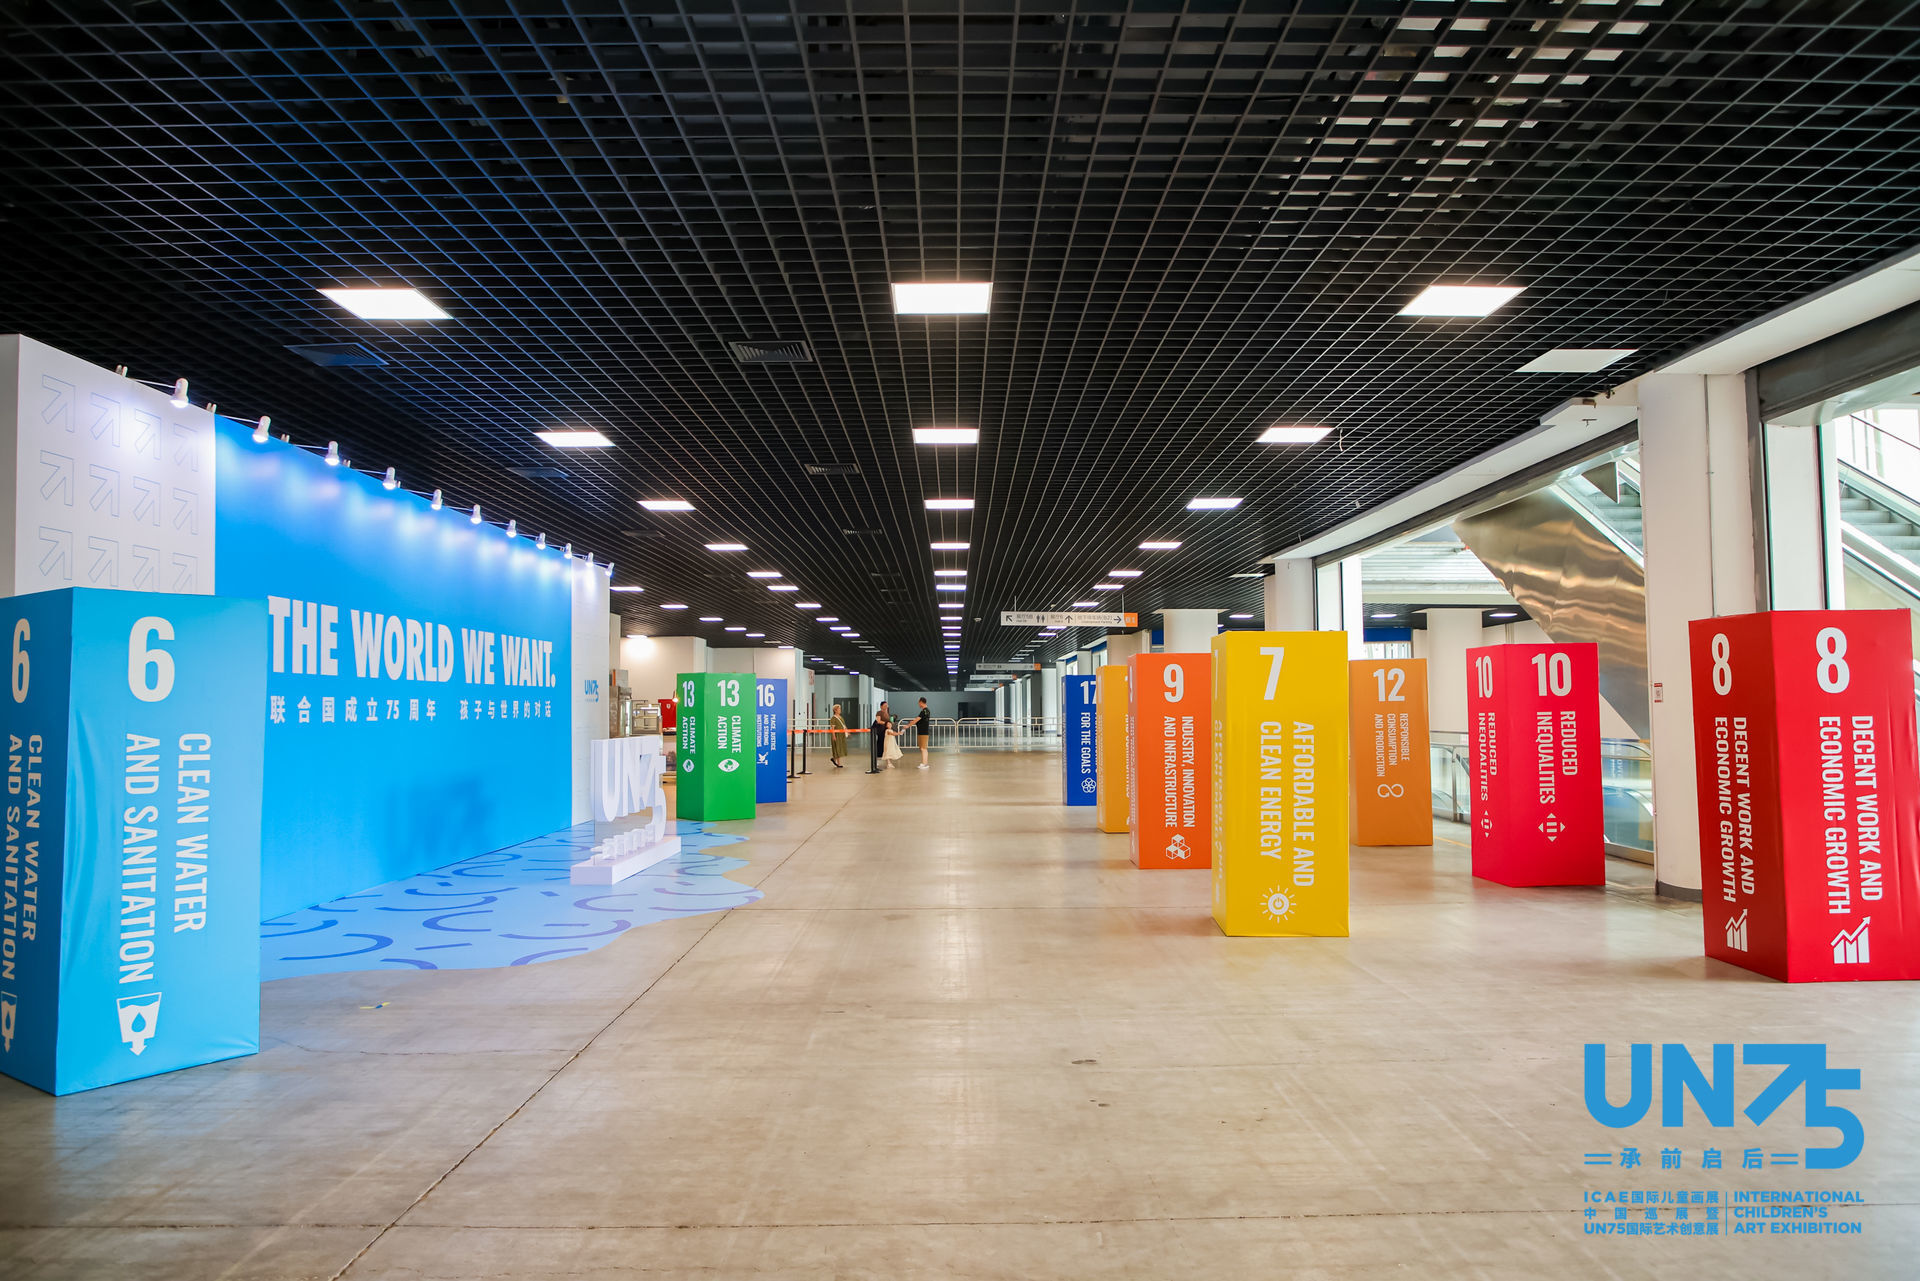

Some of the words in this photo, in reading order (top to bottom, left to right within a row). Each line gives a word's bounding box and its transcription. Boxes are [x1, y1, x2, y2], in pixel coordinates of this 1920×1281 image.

[12, 618, 31, 703] 6
[127, 616, 176, 702] 6
[268, 595, 338, 676] THE
[350, 609, 454, 682] WORLD
[461, 628, 495, 685] WE
[501, 634, 556, 688] WANT.
[1711, 633, 1732, 695] 8
[1815, 626, 1850, 694] 8
[682, 680, 695, 708] 13
[717, 679, 740, 707] 13
[756, 684, 775, 707] 16
[1163, 663, 1184, 703] 9
[1259, 646, 1284, 700] 7
[1373, 668, 1405, 702] 12
[1475, 655, 1493, 699] 10
[1531, 652, 1572, 697] 10
[270, 696, 436, 724] 联合国成立75周年
[460, 699, 552, 720] 孩子与世界的对话
[717, 716, 728, 749] ACTION
[731, 715, 742, 753] CLIMATE
[1081, 712, 1091, 728] FOR
[1081, 730, 1091, 746] THE
[1163, 716, 1176, 737] AND
[1375, 713, 1383, 729] AND
[1387, 713, 1397, 766] CONSUMPTION
[1399, 713, 1410, 761] RESPONSIBLE
[8, 734, 23, 795] AND
[125, 733, 161, 795] AND
[1081, 747, 1091, 774] GOALS
[1181, 716, 1195, 767] INDUSTRY,
[1260, 721, 1282, 780] CLEAN
[1376, 730, 1385, 777] PRODUCTION
[1478, 712, 1488, 801] INEQUALITIES
[1488, 712, 1497, 776] REDUCED
[1536, 711, 1555, 804] INEQUALITIES
[1560, 711, 1577, 776] REDUCED
[1715, 717, 1732, 815] ECONOMIC
[1733, 717, 1750, 790] DECENT
[1819, 716, 1845, 821] ECONOMIC
[1852, 715, 1877, 789] DECENT
[26, 735, 42, 828] CLEAN
[177, 733, 211, 824] CLEAN
[1164, 740, 1178, 828] INFRASTRUCTURE
[1182, 768, 1196, 828] INNOVATION
[1292, 721, 1314, 841] AFFORDABLE
[1260, 787, 1282, 860] ENERGY
[1737, 792, 1752, 850] WORK
[1856, 794, 1881, 854] WORK
[22, 841, 40, 941] WATER
[174, 833, 208, 933] WATER
[1293, 847, 1314, 887] AND
[1719, 820, 1736, 903] GROWTH
[1740, 854, 1755, 895] AND
[1824, 827, 1851, 914] GROWTH
[1859, 858, 1883, 901] AND
[1, 806, 21, 980] SANITATION
[119, 806, 157, 984] SANITATION
